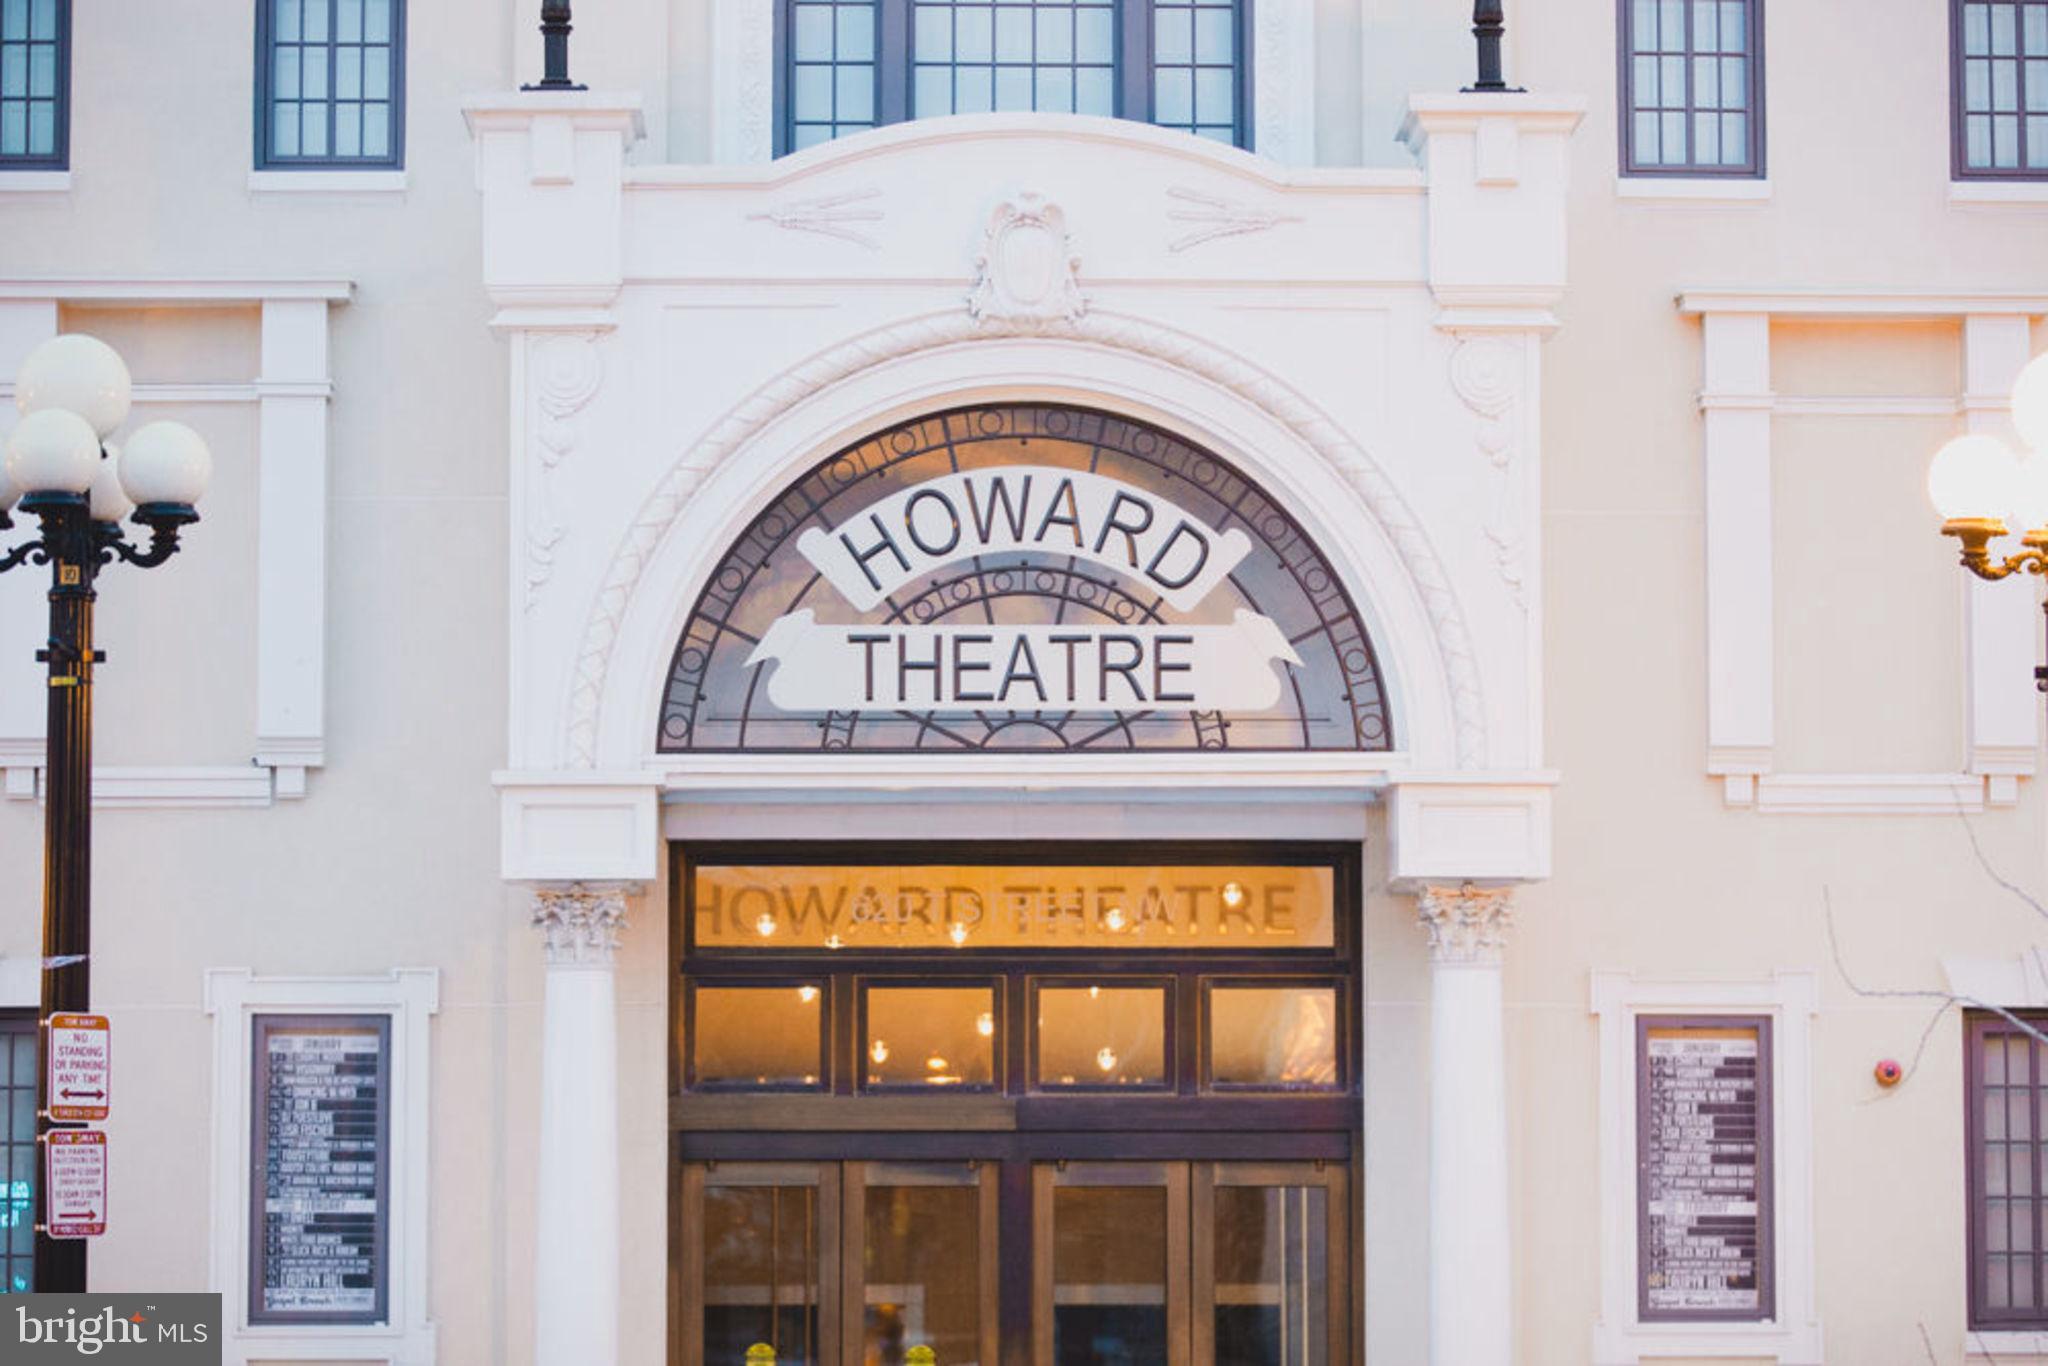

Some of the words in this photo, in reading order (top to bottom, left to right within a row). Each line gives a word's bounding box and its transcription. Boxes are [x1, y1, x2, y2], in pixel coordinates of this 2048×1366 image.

[839, 475, 1209, 591] HOWARD
[847, 634, 1195, 702] THEATRE
[851, 892, 914, 923] 620
[72, 1033, 89, 1043] NO
[57, 1046, 103, 1057] STANDING
[54, 1060, 67, 1071] OR
[69, 1060, 106, 1071] PARKING
[57, 1074, 78, 1084] ANY
[82, 1074, 102, 1084] TIME
